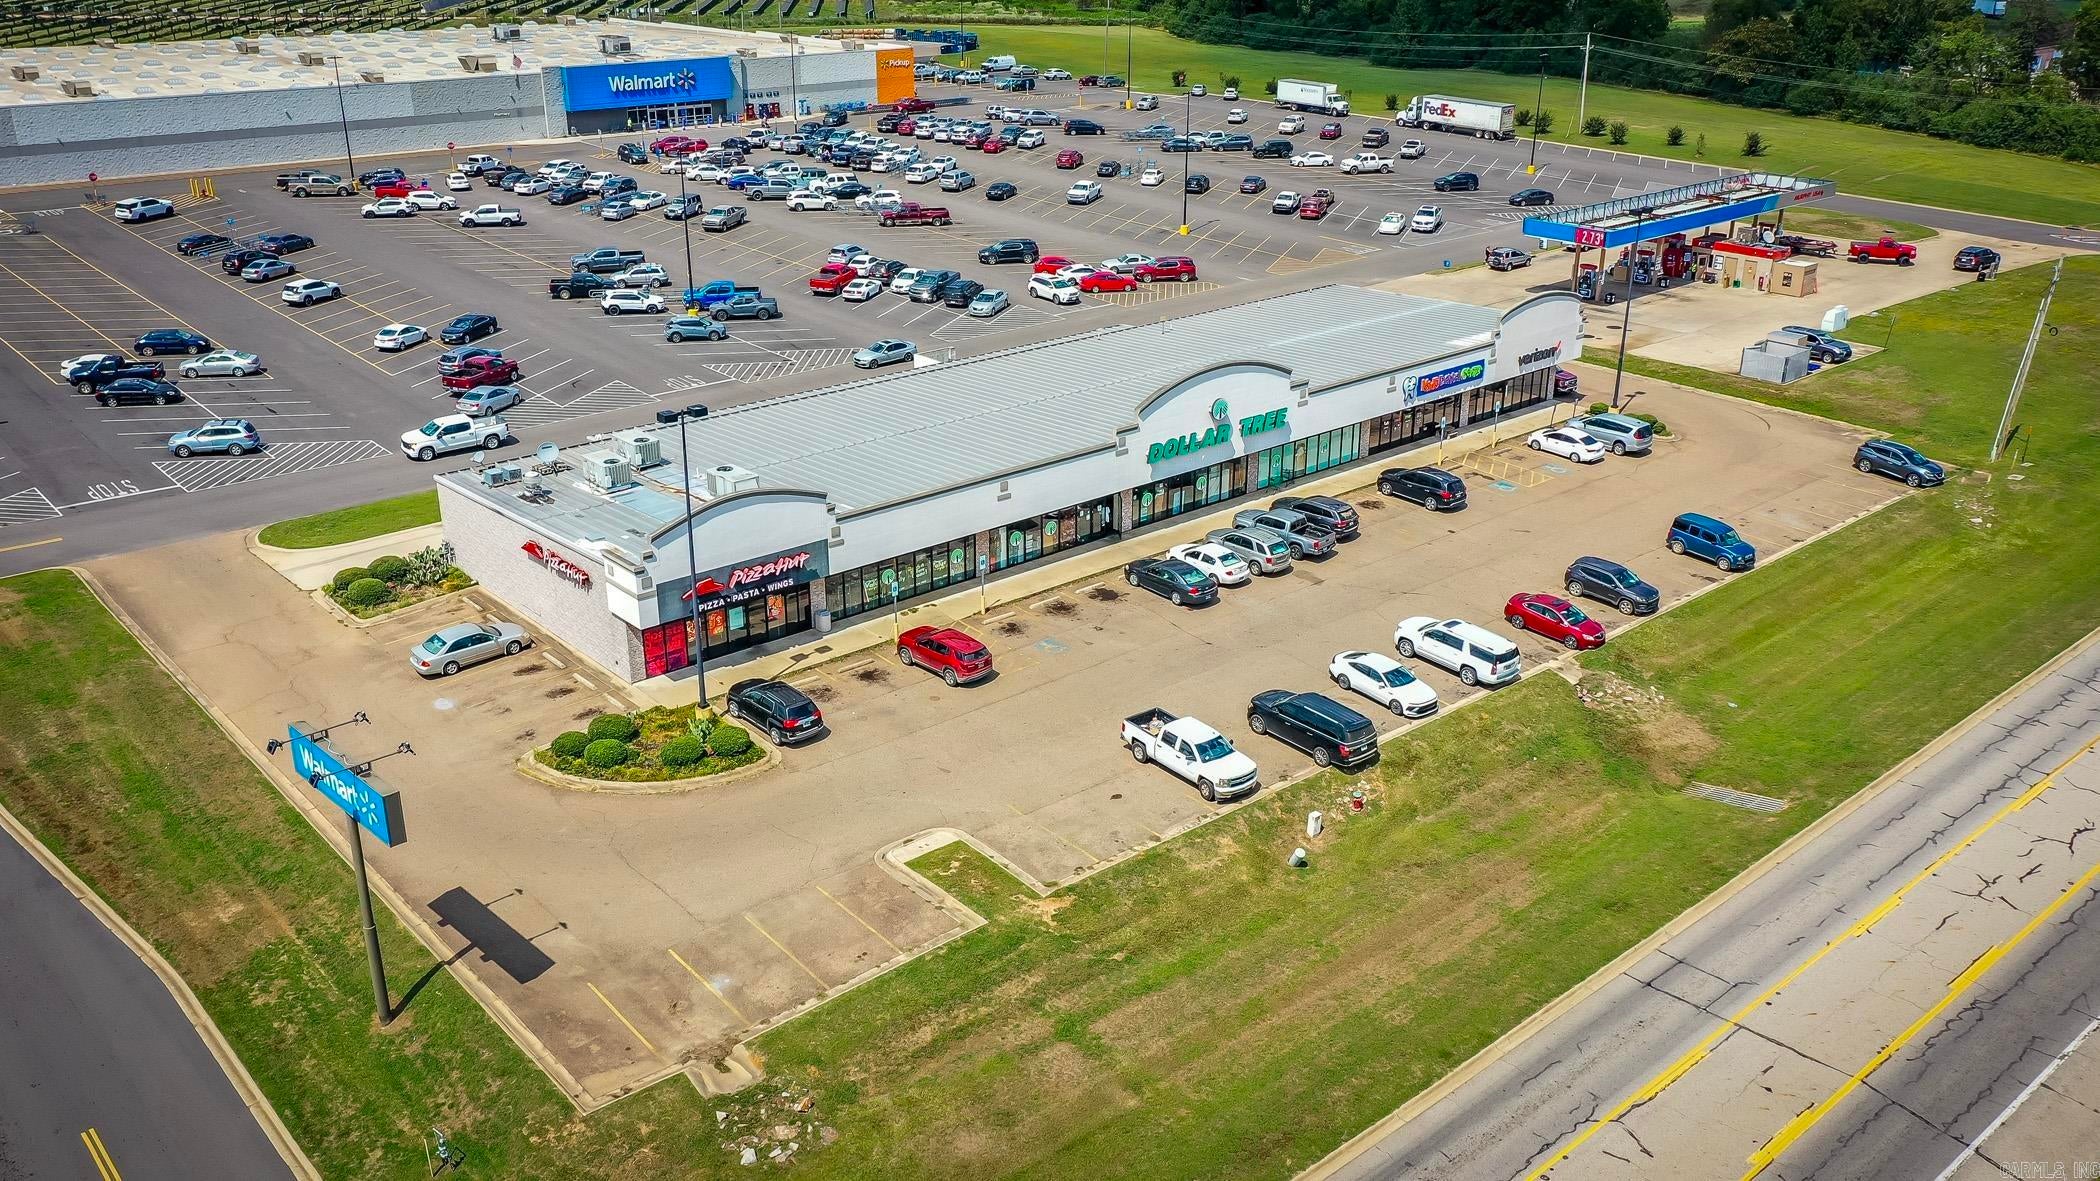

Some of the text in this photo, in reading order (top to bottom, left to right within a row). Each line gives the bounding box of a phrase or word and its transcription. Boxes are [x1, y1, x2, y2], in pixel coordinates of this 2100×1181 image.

[608, 72, 676, 92] Walmart
[1423, 101, 1456, 118] FedEx
[33, 208, 64, 217] STOP
[1518, 347, 1558, 367] verizon
[1147, 407, 1288, 465] DOLLAR TREE
[87, 479, 139, 500] STOP
[698, 578, 794, 613] PIZZA PASTA WINGS
